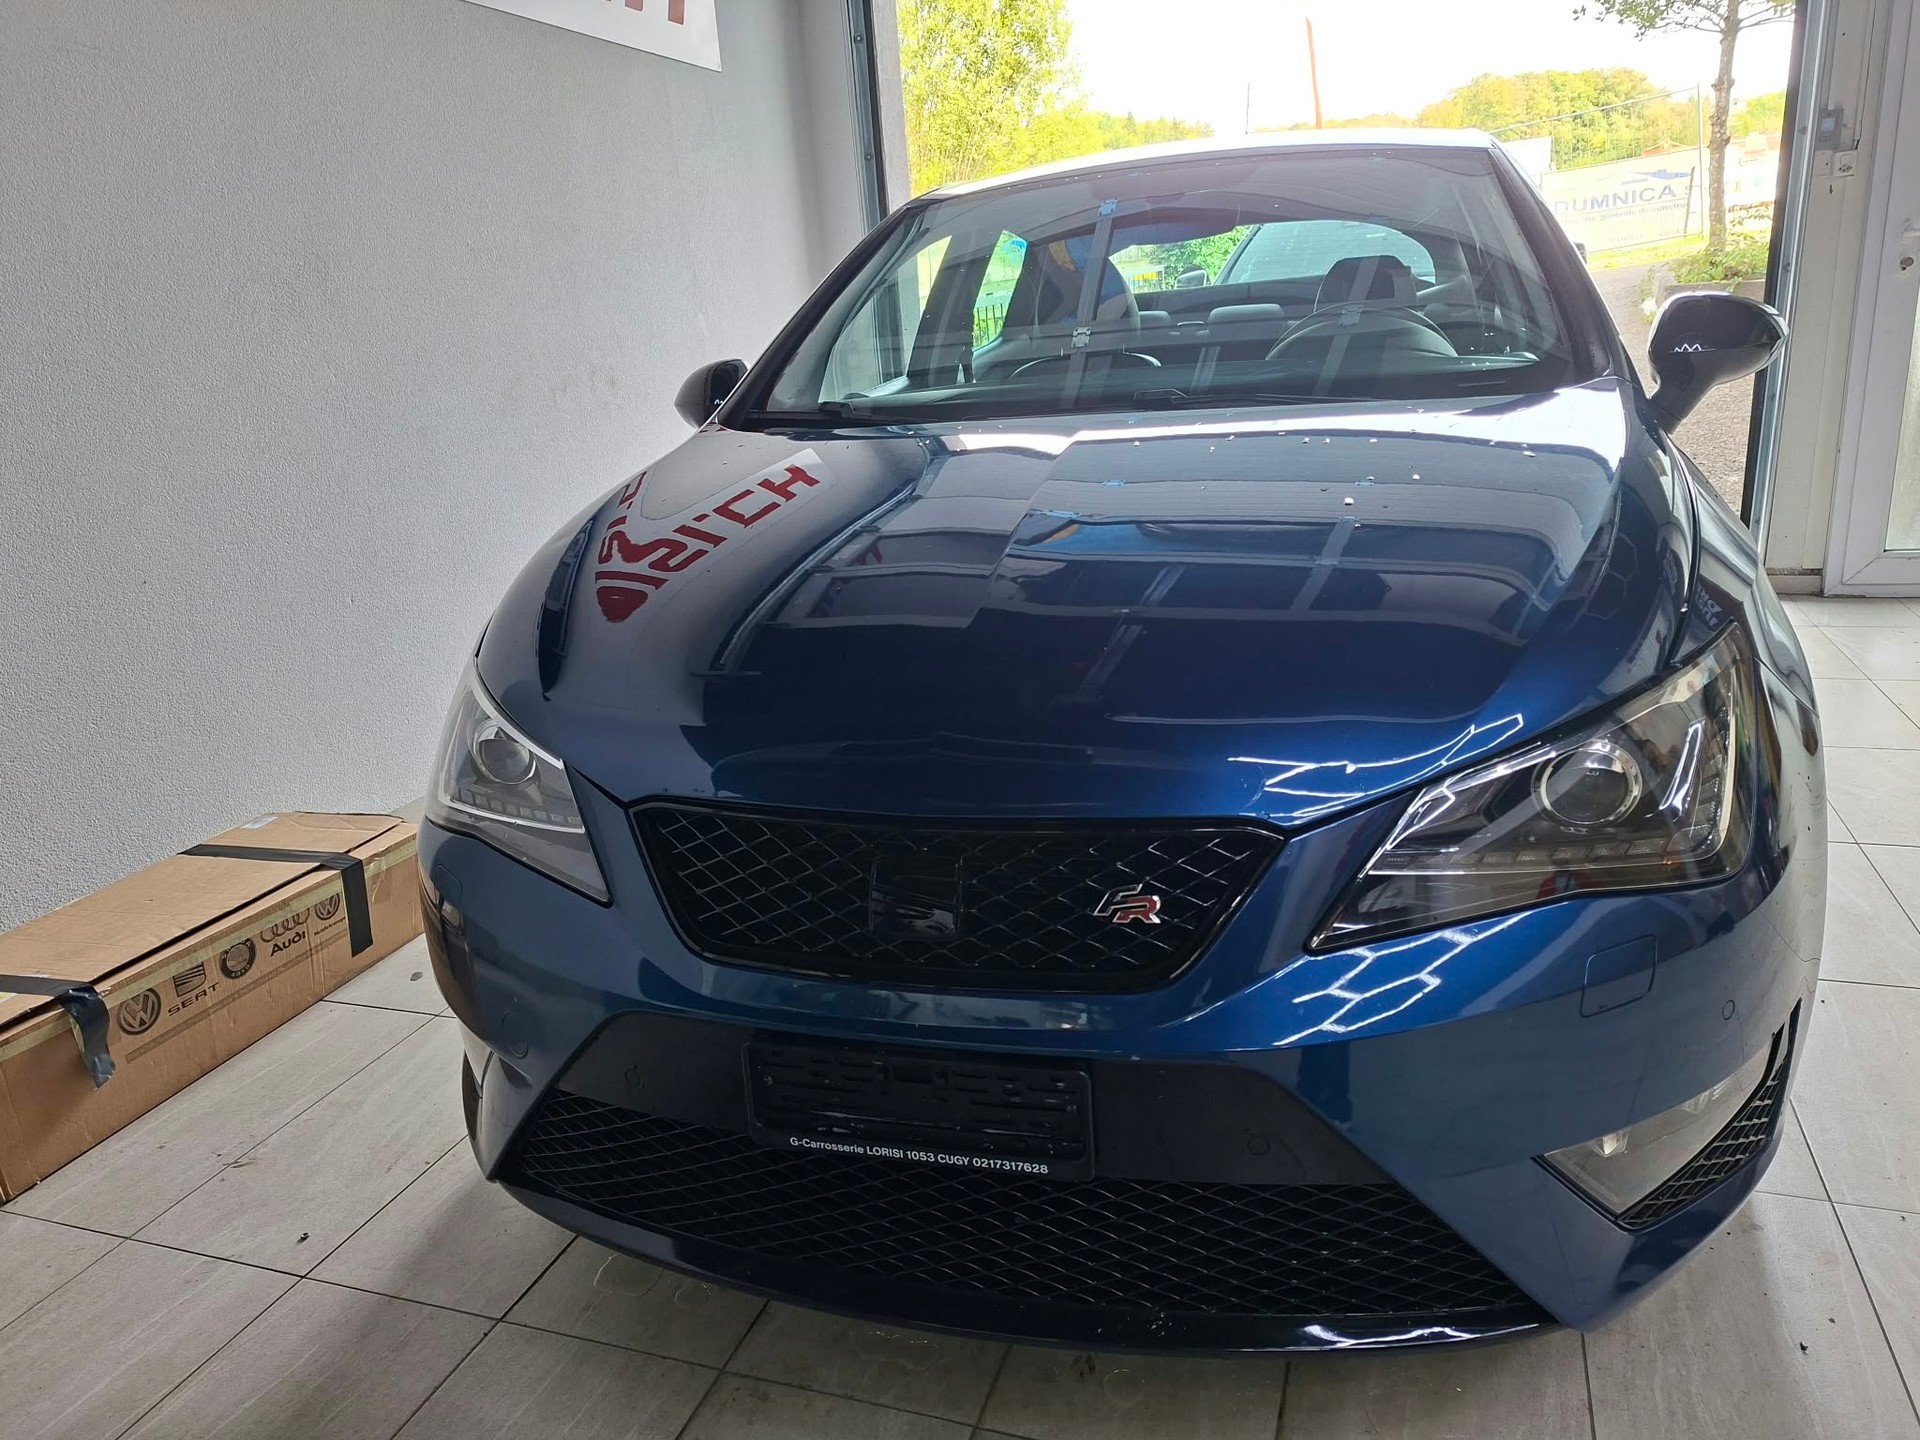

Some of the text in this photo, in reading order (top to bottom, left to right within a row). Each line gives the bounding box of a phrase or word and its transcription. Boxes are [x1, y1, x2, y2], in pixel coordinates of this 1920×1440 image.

[1093, 883, 1161, 924] FR
[270, 931, 306, 957] Audi
[168, 982, 219, 1016] SEAT
[790, 1137, 1049, 1175] G-Carrosserie LORISI 1053 CUGY 0217317628
